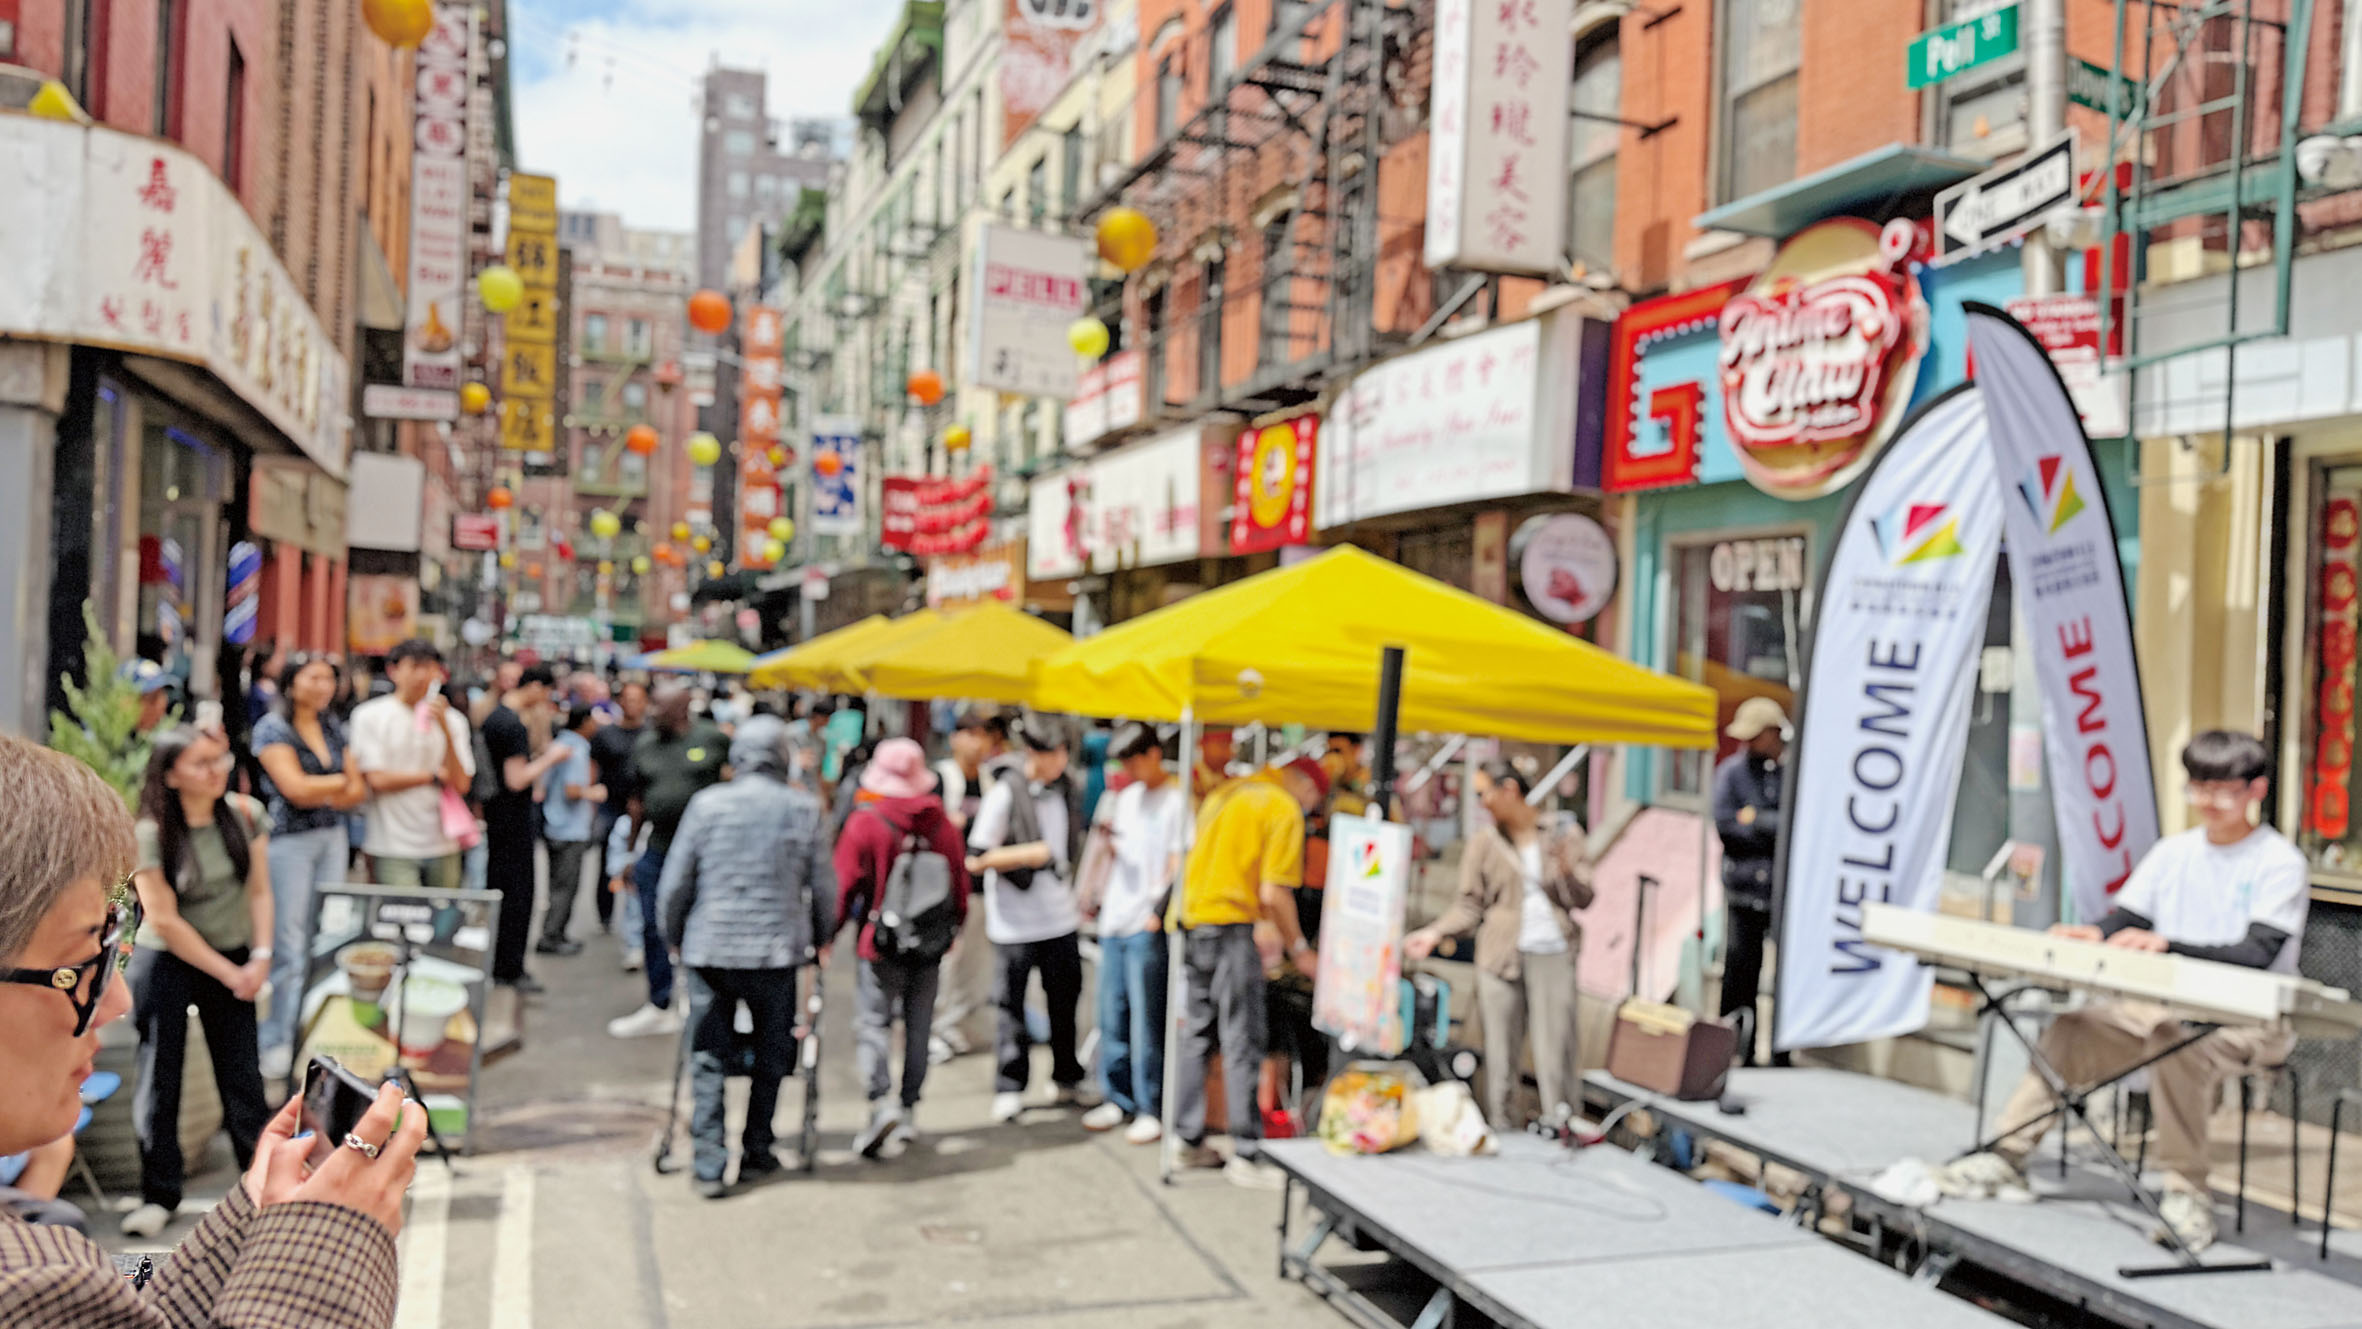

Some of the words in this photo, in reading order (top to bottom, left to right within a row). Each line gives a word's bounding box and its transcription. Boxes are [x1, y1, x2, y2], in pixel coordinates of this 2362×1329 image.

[1926, 24, 1976, 78] Pell
[2018, 166, 2060, 204] WAY
[985, 262, 1082, 309] PELL
[1722, 302, 1852, 369] Anime
[1742, 354, 1864, 424] Claw
[1710, 537, 1804, 592] OPEN
[2059, 616, 2132, 900] LCOME
[1830, 636, 1922, 975] WELCOME
